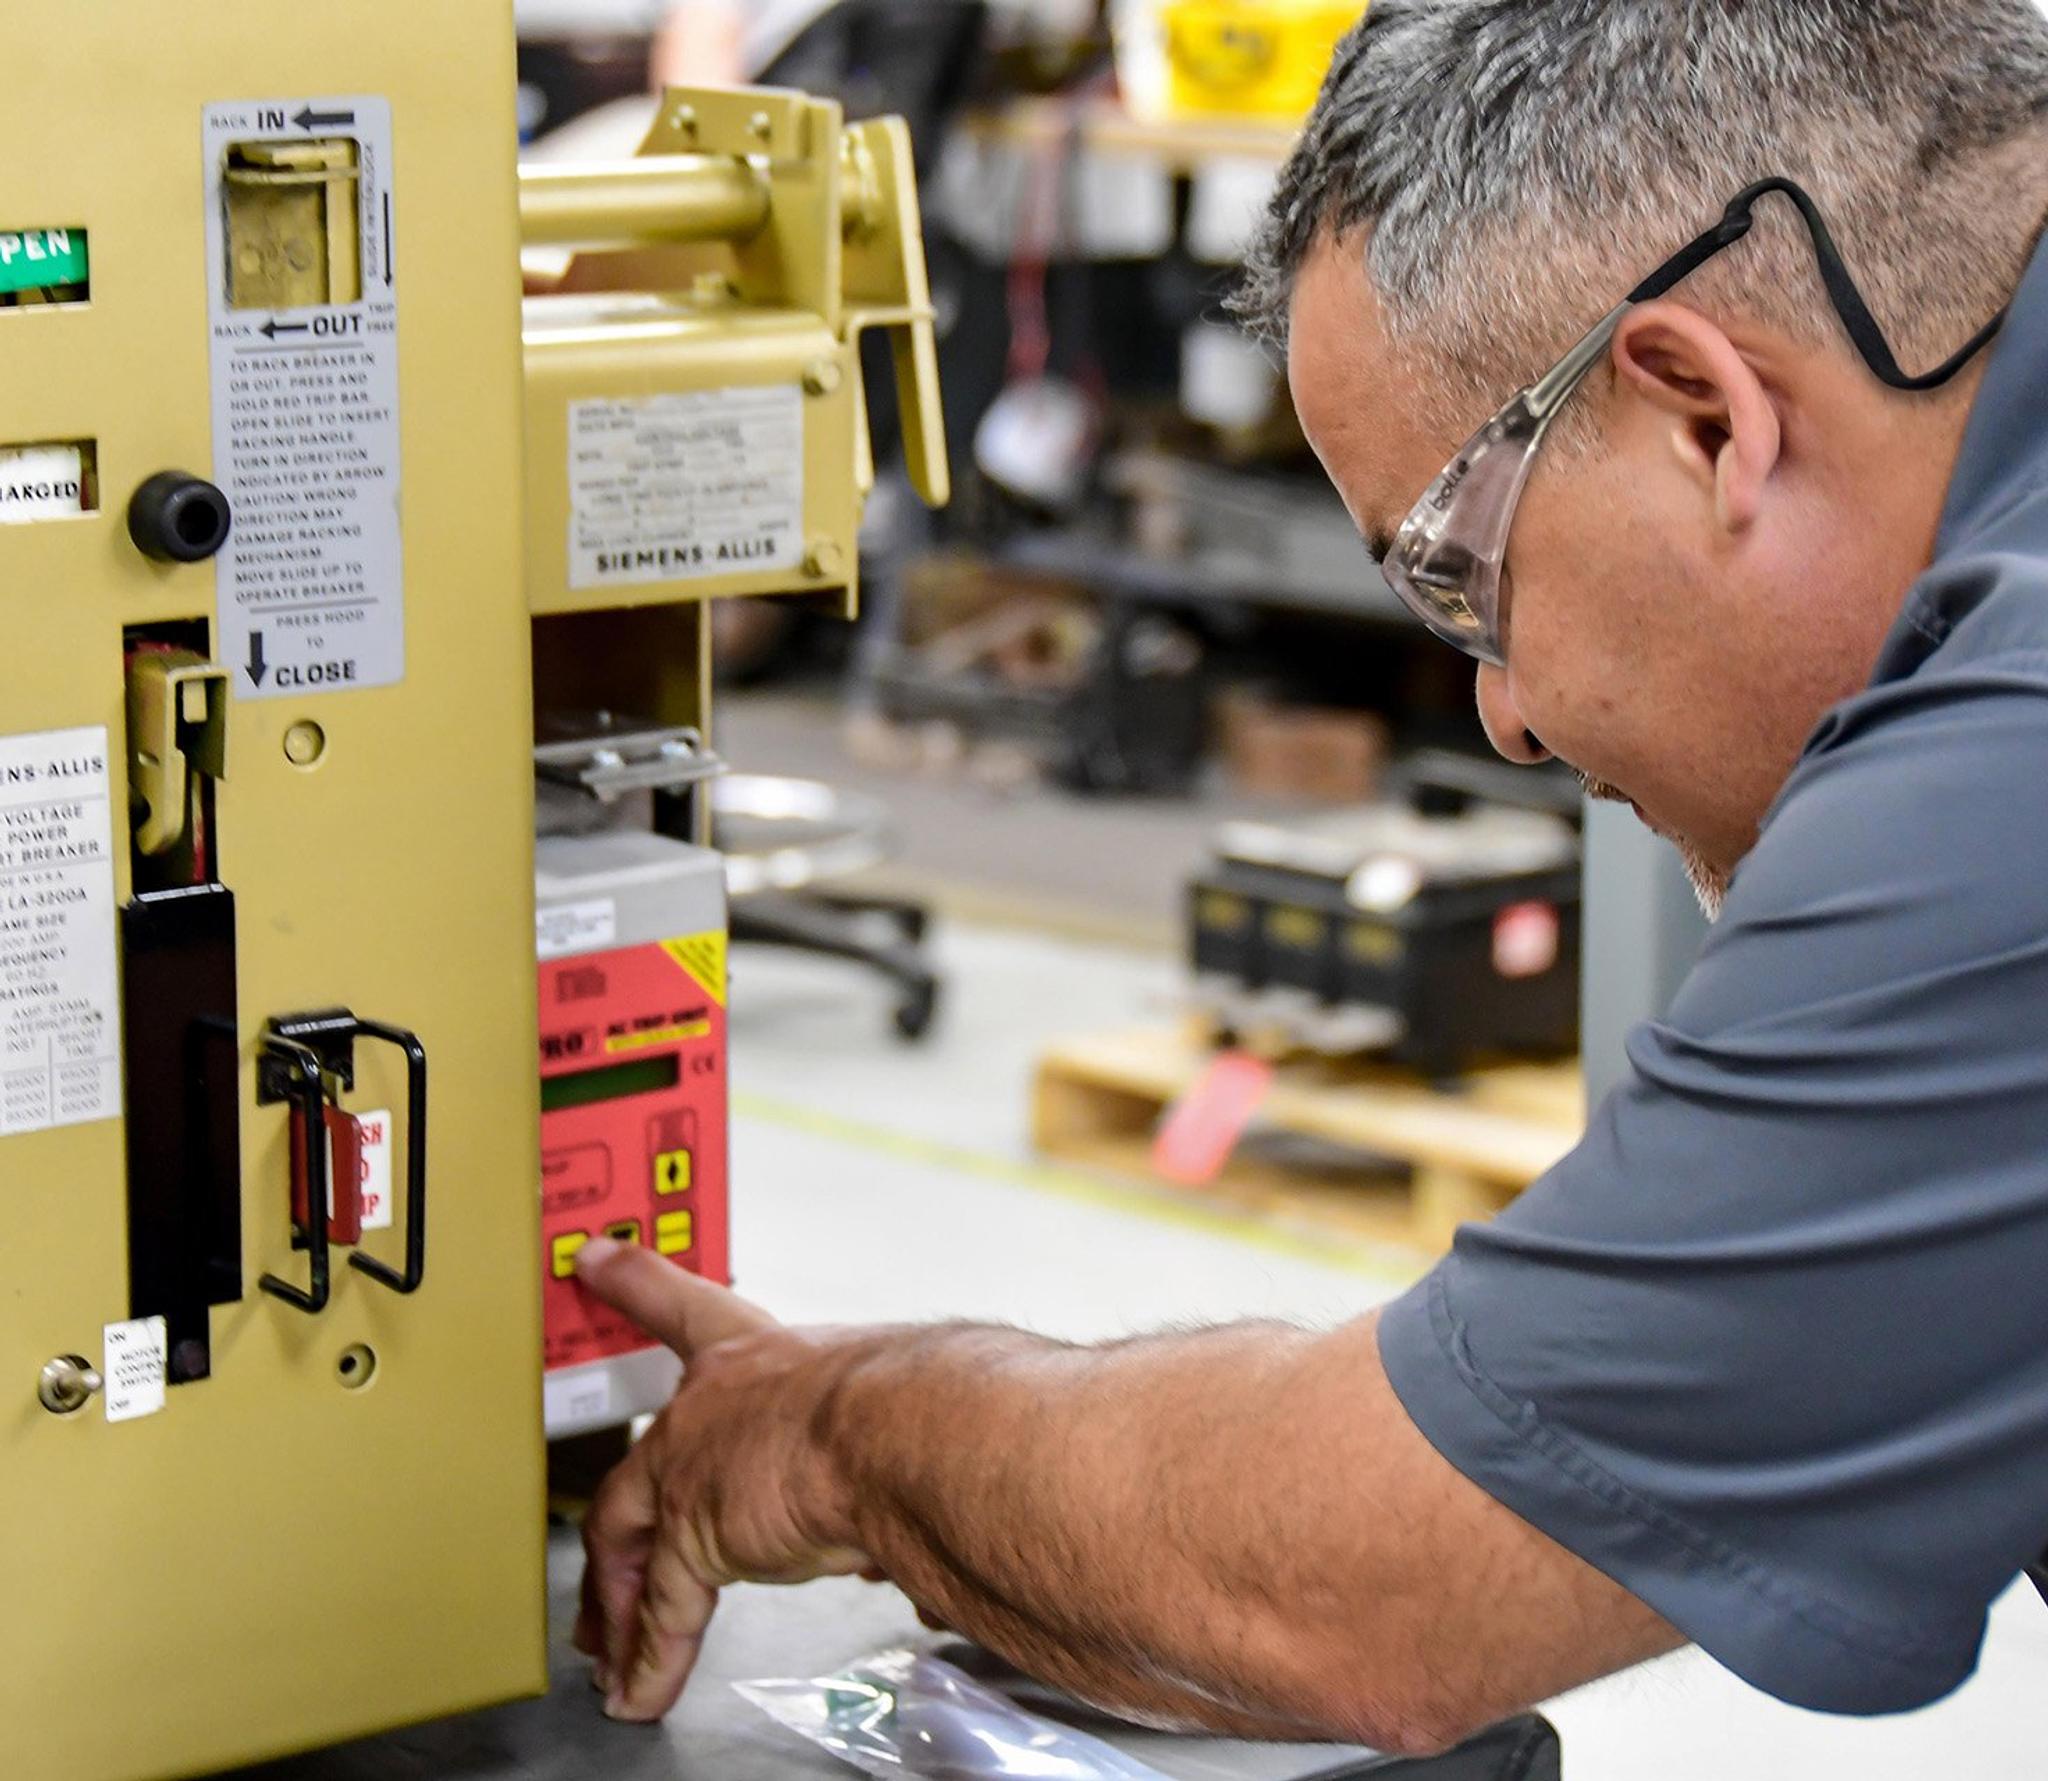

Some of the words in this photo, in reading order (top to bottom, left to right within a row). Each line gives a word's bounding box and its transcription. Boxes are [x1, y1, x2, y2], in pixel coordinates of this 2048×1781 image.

[257, 109, 285, 130] IN
[312, 314, 363, 337] OUT
[230, 360, 247, 373] TO
[251, 358, 288, 370] RACK
[293, 354, 356, 369] BREAKER
[360, 352, 375, 365] IN
[230, 380, 249, 393] OR
[289, 375, 333, 387] PRESS
[338, 373, 367, 386] AND
[230, 397, 269, 411] HOLD
[273, 396, 300, 408] RED
[305, 394, 335, 406] TRIP
[230, 417, 268, 430] OPEN
[273, 415, 312, 427] SLIDE
[318, 413, 336, 425] TO
[340, 409, 389, 423] INSERT
[231, 435, 295, 449] RACKING
[232, 456, 270, 469] TURN
[273, 454, 288, 466] IN
[292, 449, 368, 466] DIRECTION
[232, 472, 308, 488] INDICATED
[312, 470, 329, 483] BY
[303, 487, 357, 503] WRONG
[233, 509, 308, 527] DIRECTION
[312, 507, 343, 520] MAY
[233, 530, 293, 546] DAMAGE
[299, 524, 362, 540] RACKING
[235, 569, 274, 584] MOVE
[279, 566, 317, 581] SLIDE
[322, 564, 340, 577] UP
[345, 561, 363, 574] TO
[235, 588, 297, 604] OPERATE
[302, 581, 365, 597] BREAKER
[275, 613, 320, 627] PRESS
[324, 609, 365, 624] HOOD
[305, 636, 324, 648] TO
[274, 658, 357, 688] CLOSE
[7, 825, 69, 845] POWER
[21, 838, 100, 864] BREAKER
[360, 1123, 382, 1145] SH
[364, 1194, 380, 1216] IP
